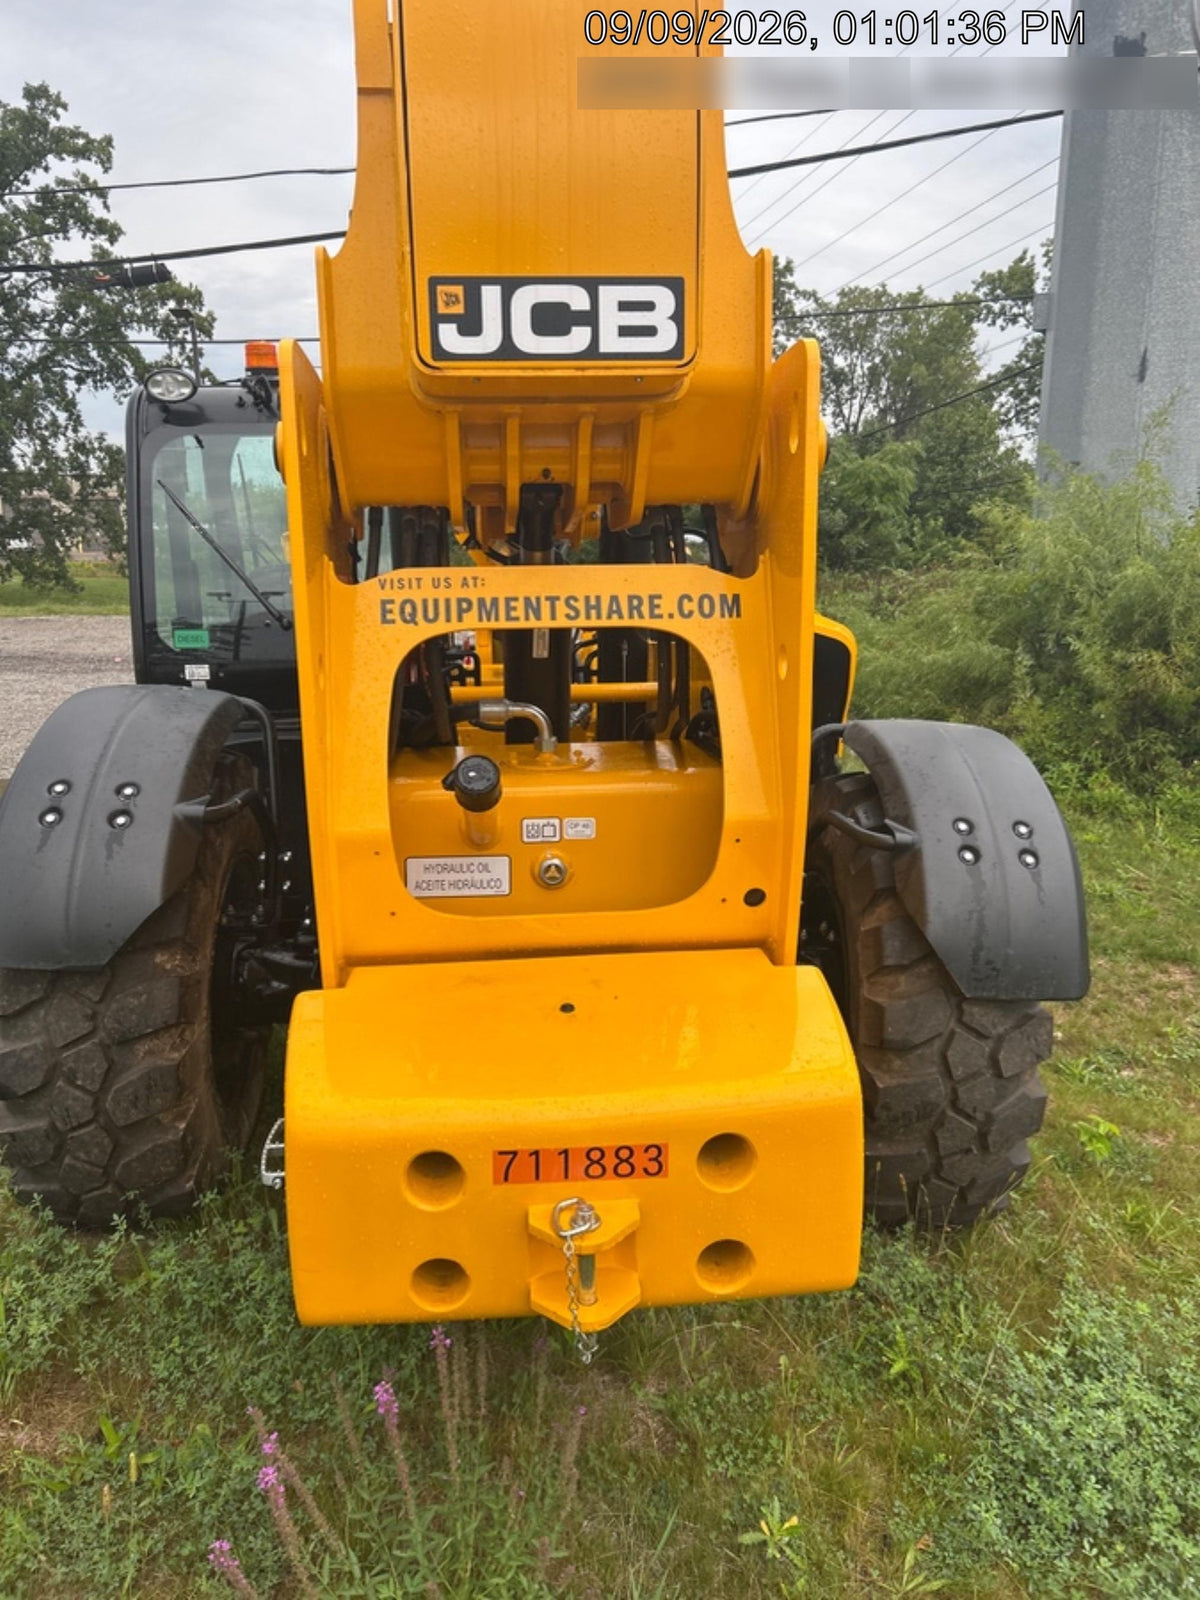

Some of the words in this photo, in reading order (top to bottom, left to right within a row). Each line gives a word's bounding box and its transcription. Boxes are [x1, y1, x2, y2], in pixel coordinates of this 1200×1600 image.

[438, 284, 678, 354] JCB
[378, 577, 423, 591] VISIT
[431, 576, 453, 589] US
[460, 576, 486, 589] AT:
[380, 593, 742, 626] EQUIPMENTSHARE.COM
[423, 863, 475, 875] HYDRAULIC
[476, 862, 491, 874] OIL
[414, 879, 446, 892] ACEITE
[497, 1144, 664, 1183] 711883
